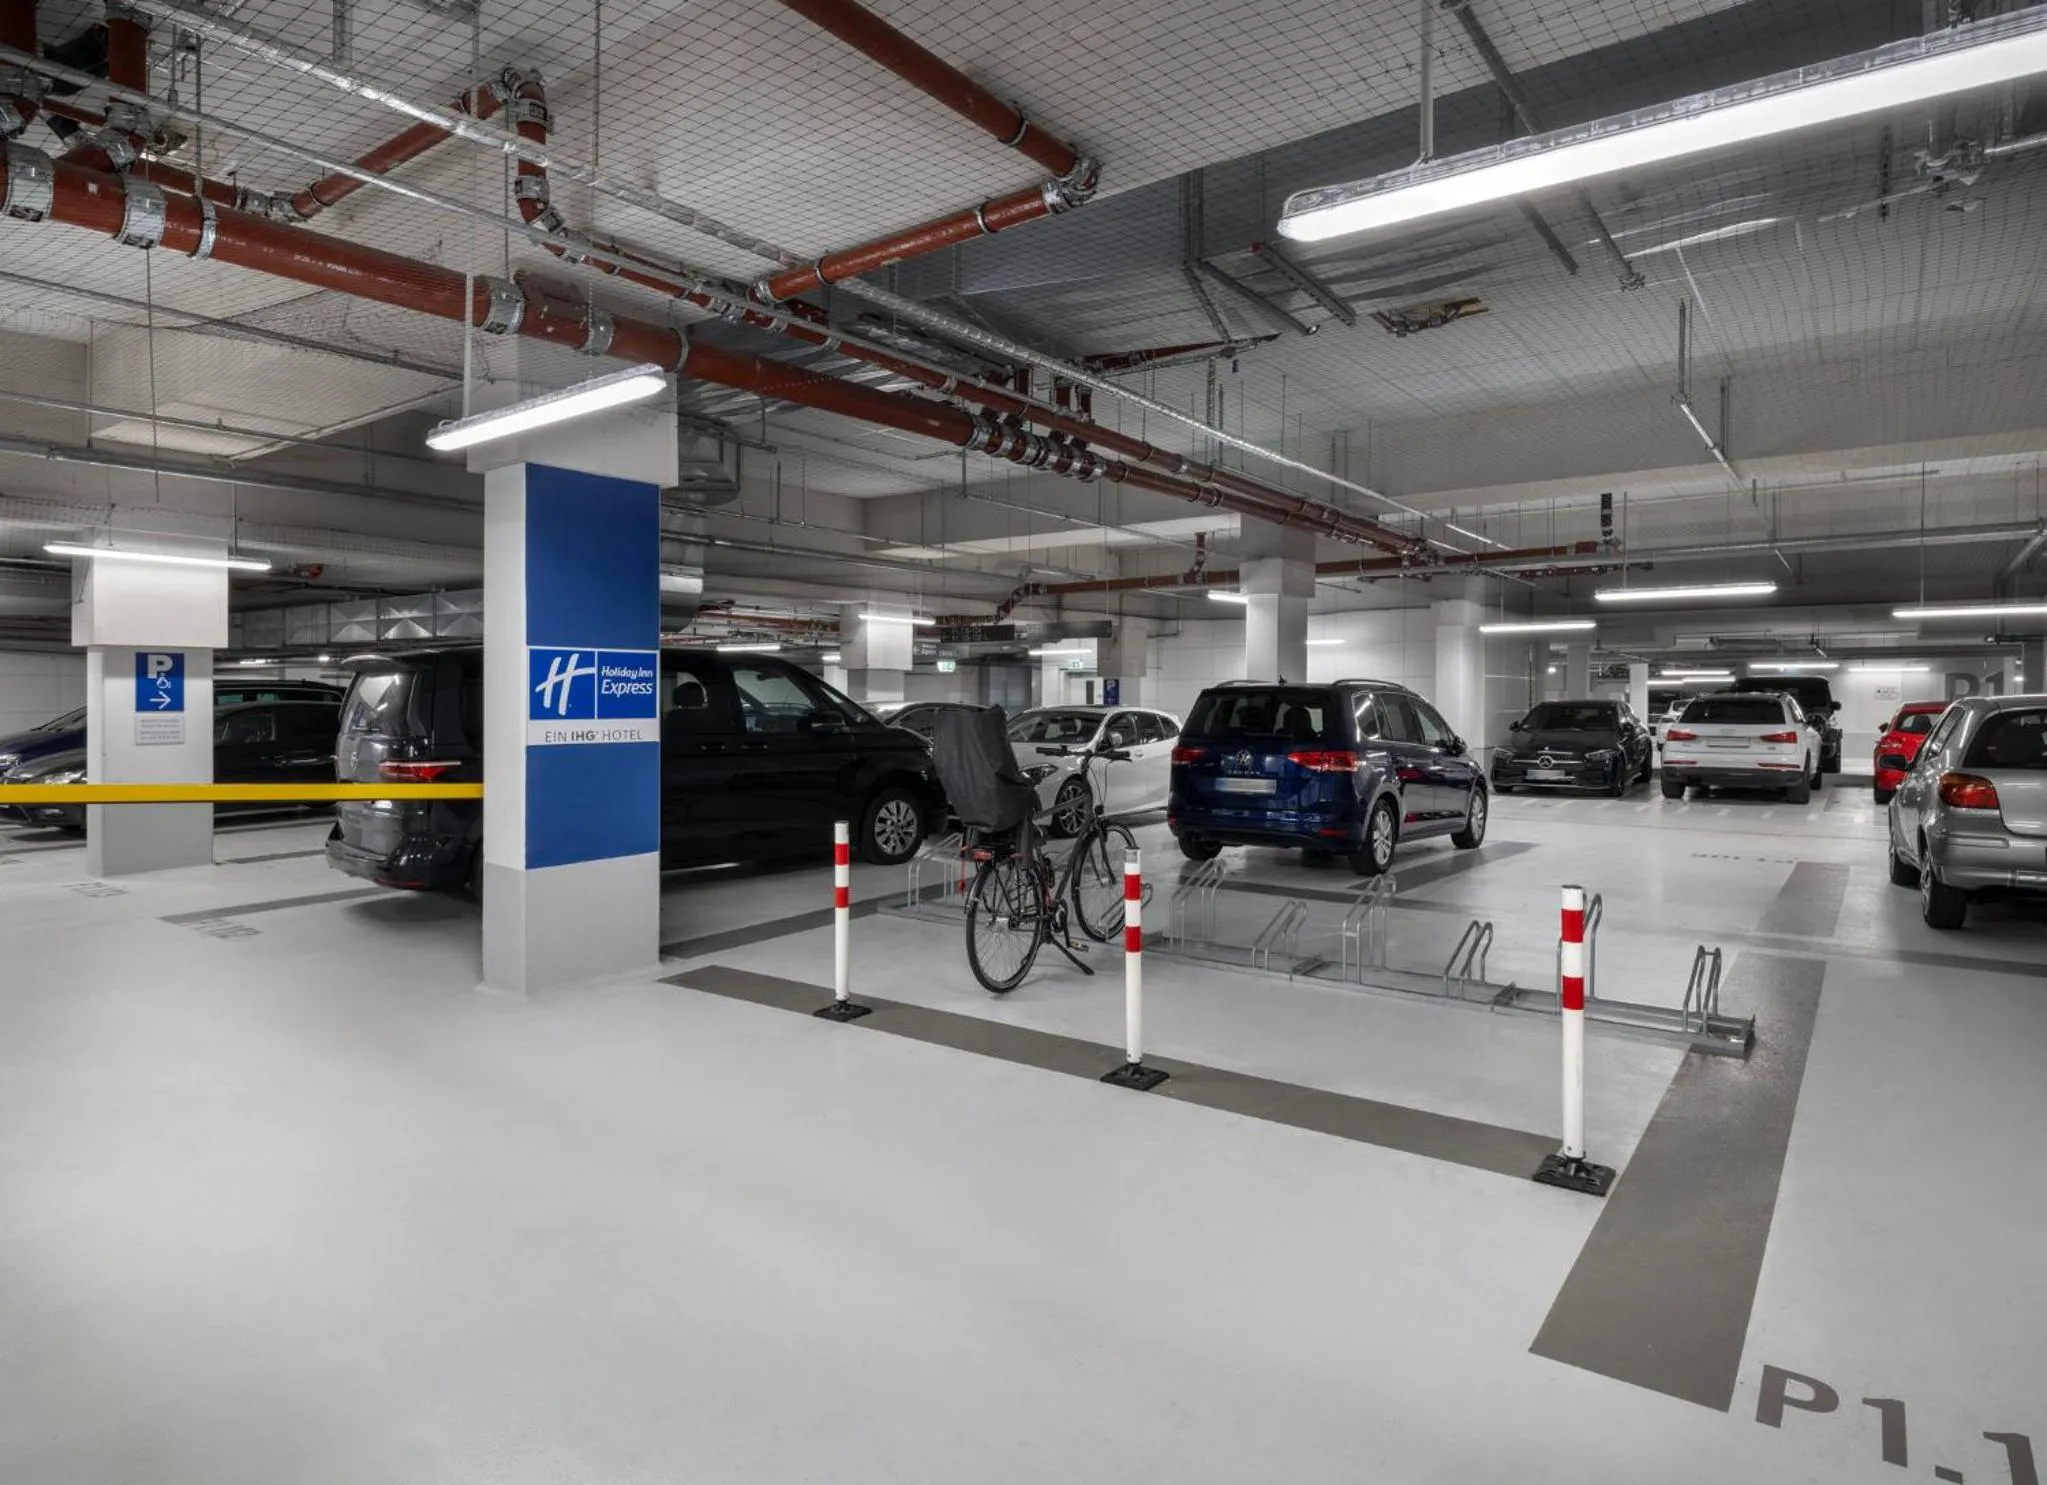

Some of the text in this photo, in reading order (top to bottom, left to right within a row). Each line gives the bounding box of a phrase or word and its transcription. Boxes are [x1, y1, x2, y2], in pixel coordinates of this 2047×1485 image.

[147, 654, 173, 679] P
[601, 665, 653, 679] Holiday Inn
[601, 679, 653, 698] Express
[1106, 680, 1116, 691] P
[1945, 671, 2004, 700] P1
[544, 731, 567, 743] EIN
[602, 729, 642, 741] HOTEL
